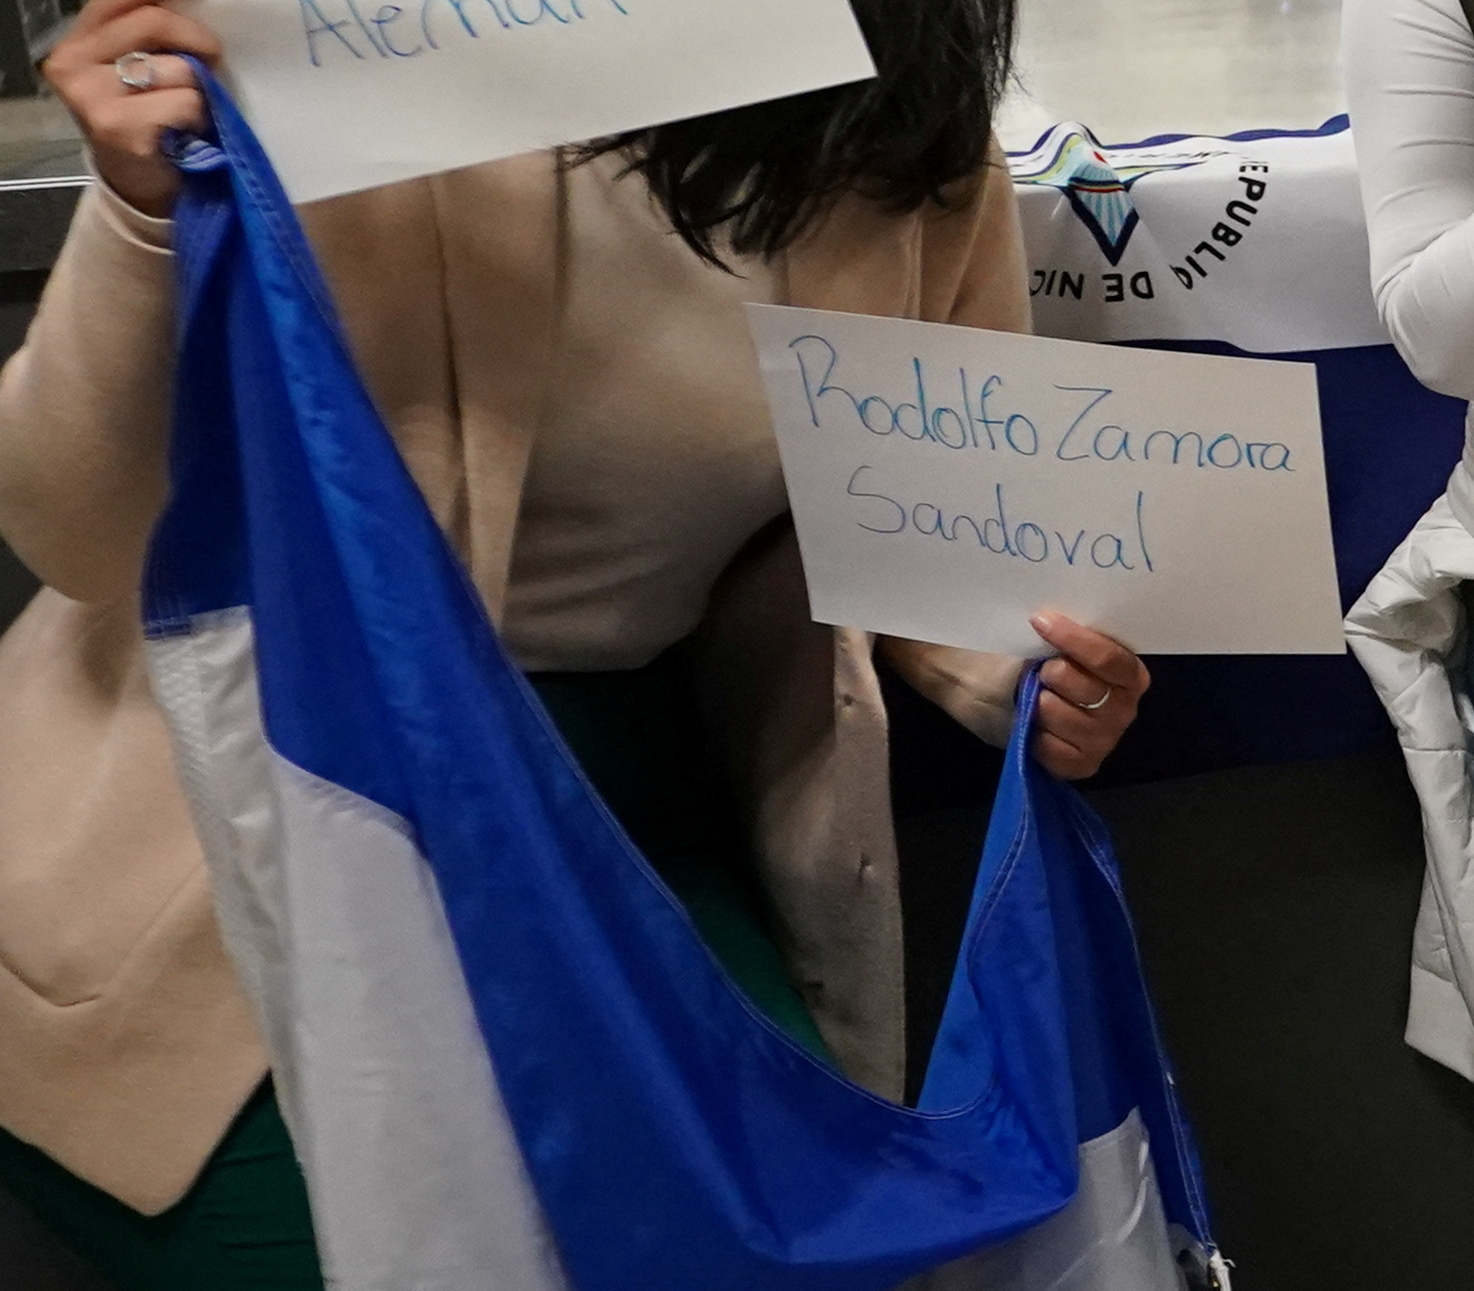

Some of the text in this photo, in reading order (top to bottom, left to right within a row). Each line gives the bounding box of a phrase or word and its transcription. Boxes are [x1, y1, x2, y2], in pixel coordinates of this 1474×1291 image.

[1028, 270, 1084, 300] NIC
[1102, 271, 1154, 302] DE
[789, 335, 1296, 474] Rodolfo Zamora
[847, 465, 1154, 573] Sandoval
